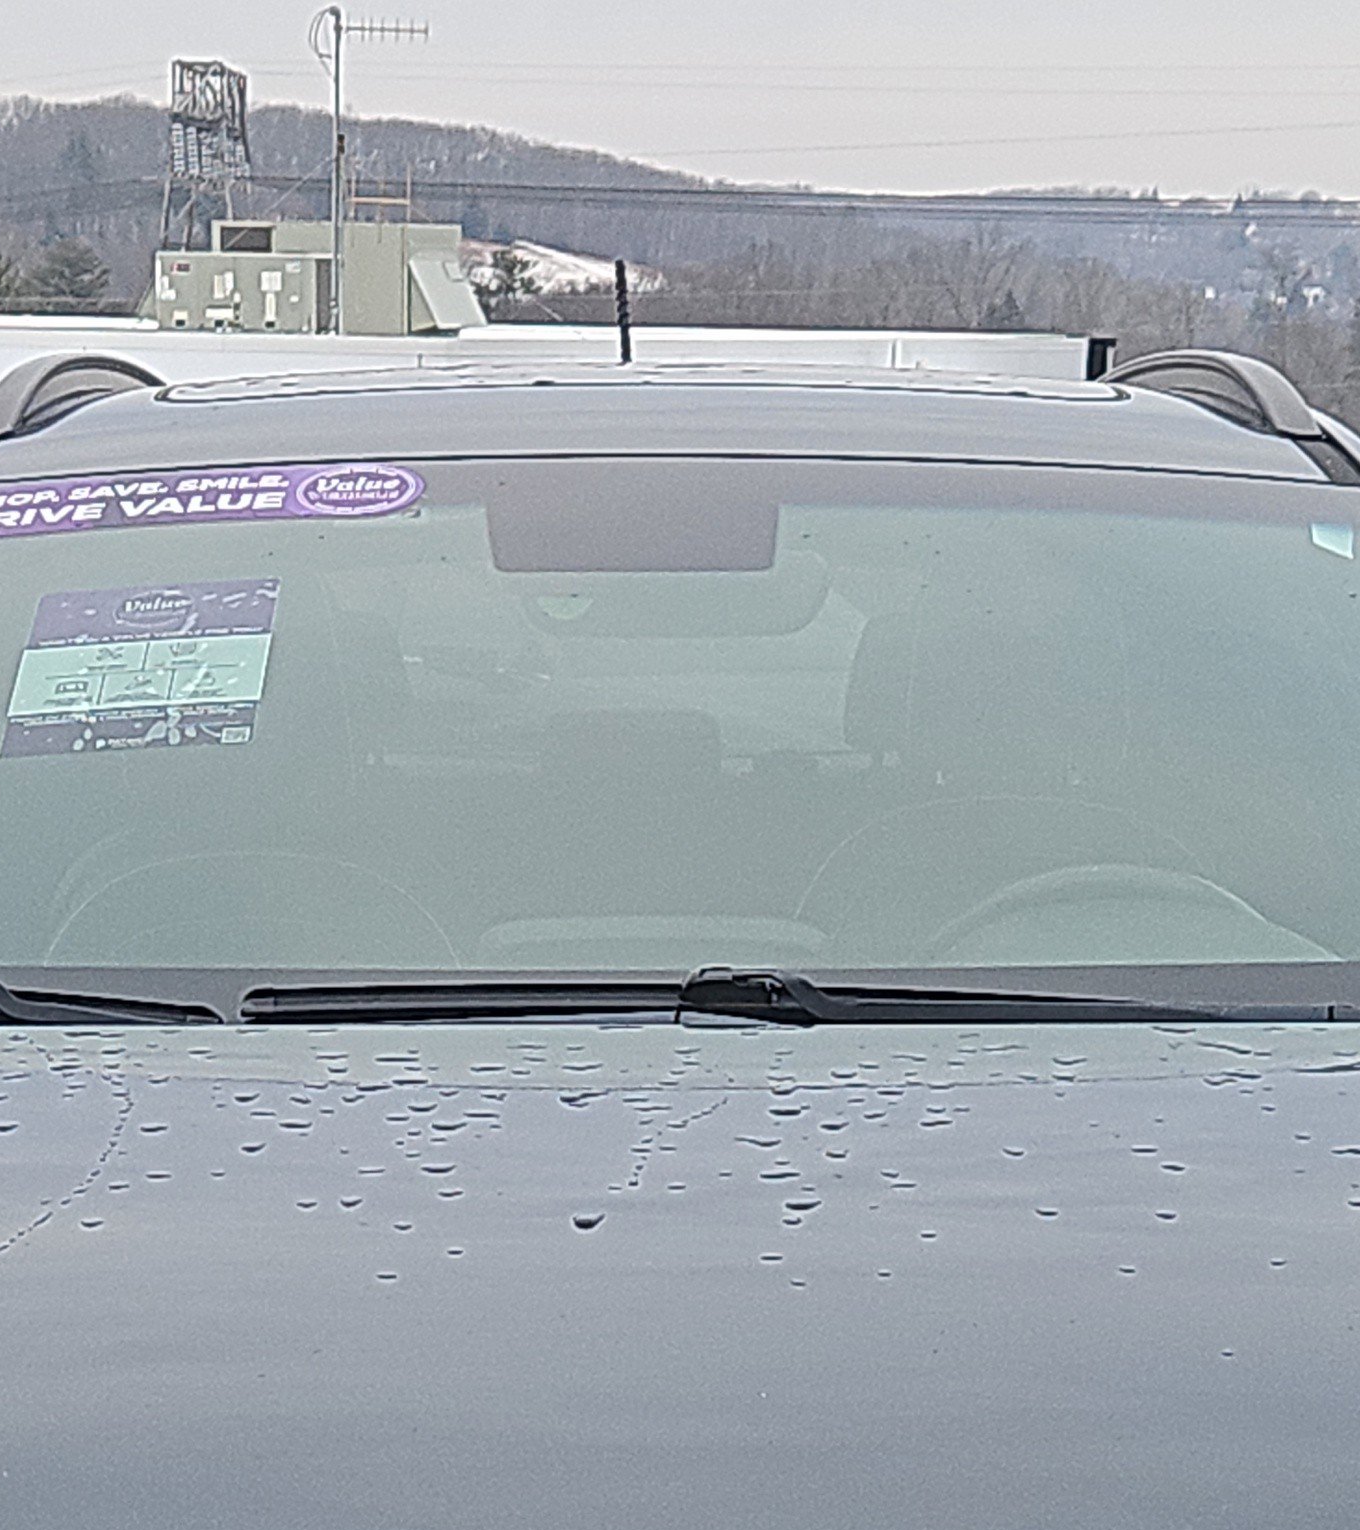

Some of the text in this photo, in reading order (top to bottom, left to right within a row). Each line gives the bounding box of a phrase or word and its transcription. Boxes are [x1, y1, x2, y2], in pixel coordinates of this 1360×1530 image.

[67, 481, 170, 501] SAVE.
[175, 474, 290, 494] SMILE.
[316, 476, 401, 493] Value
[119, 491, 287, 518] VALUE
